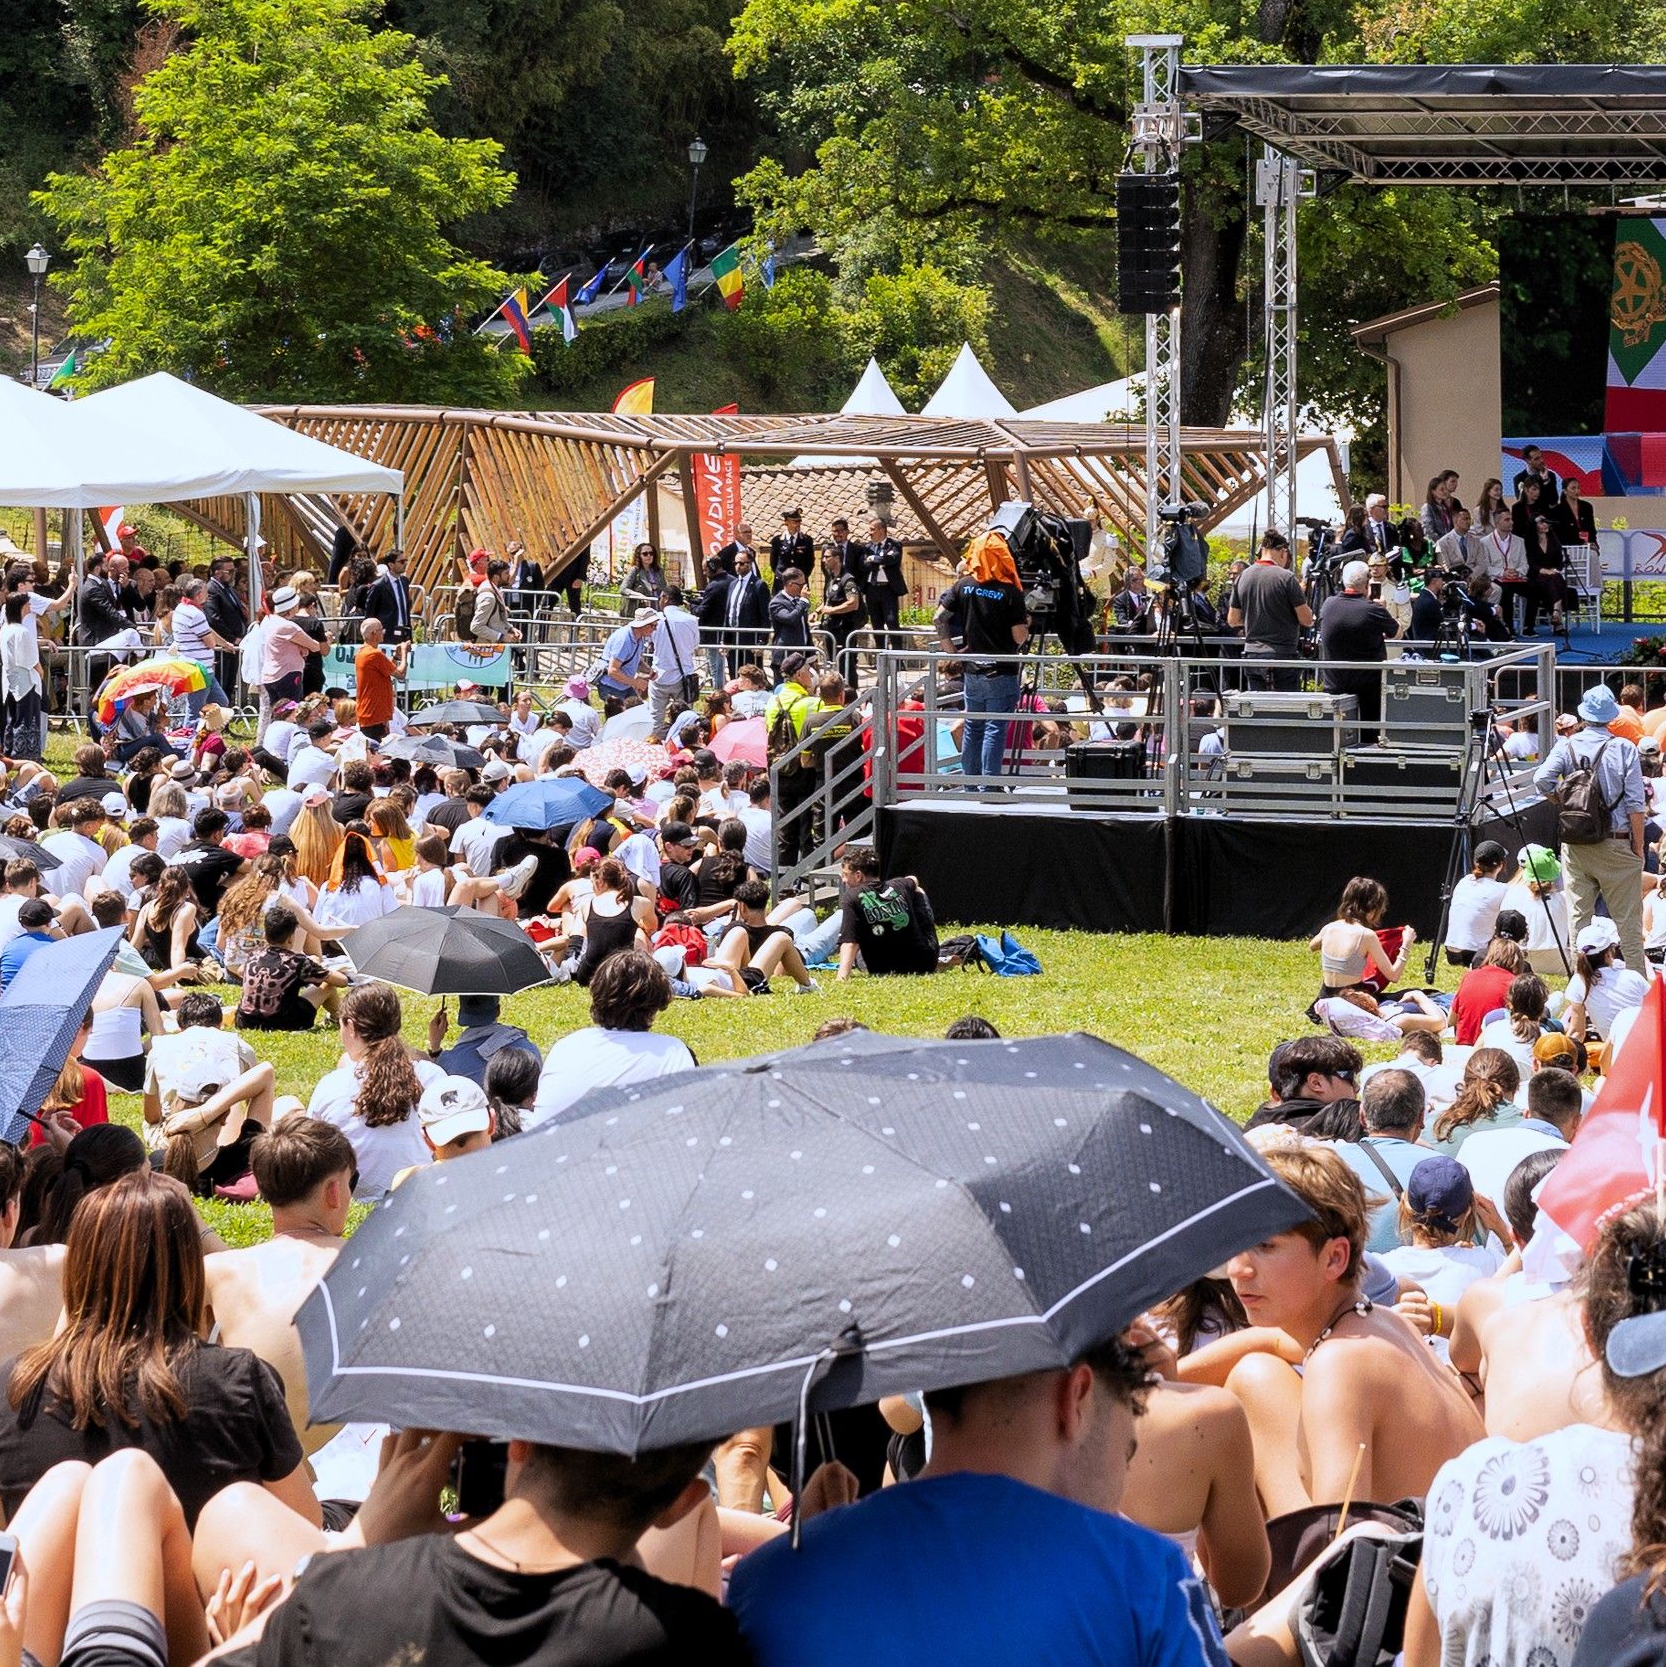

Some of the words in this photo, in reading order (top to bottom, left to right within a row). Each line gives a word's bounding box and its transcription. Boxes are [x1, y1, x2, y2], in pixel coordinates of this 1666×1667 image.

[724, 459, 733, 485] PACE
[704, 451, 725, 557] ONDINE
[963, 585, 975, 595] TV
[975, 587, 1004, 601] CREW
